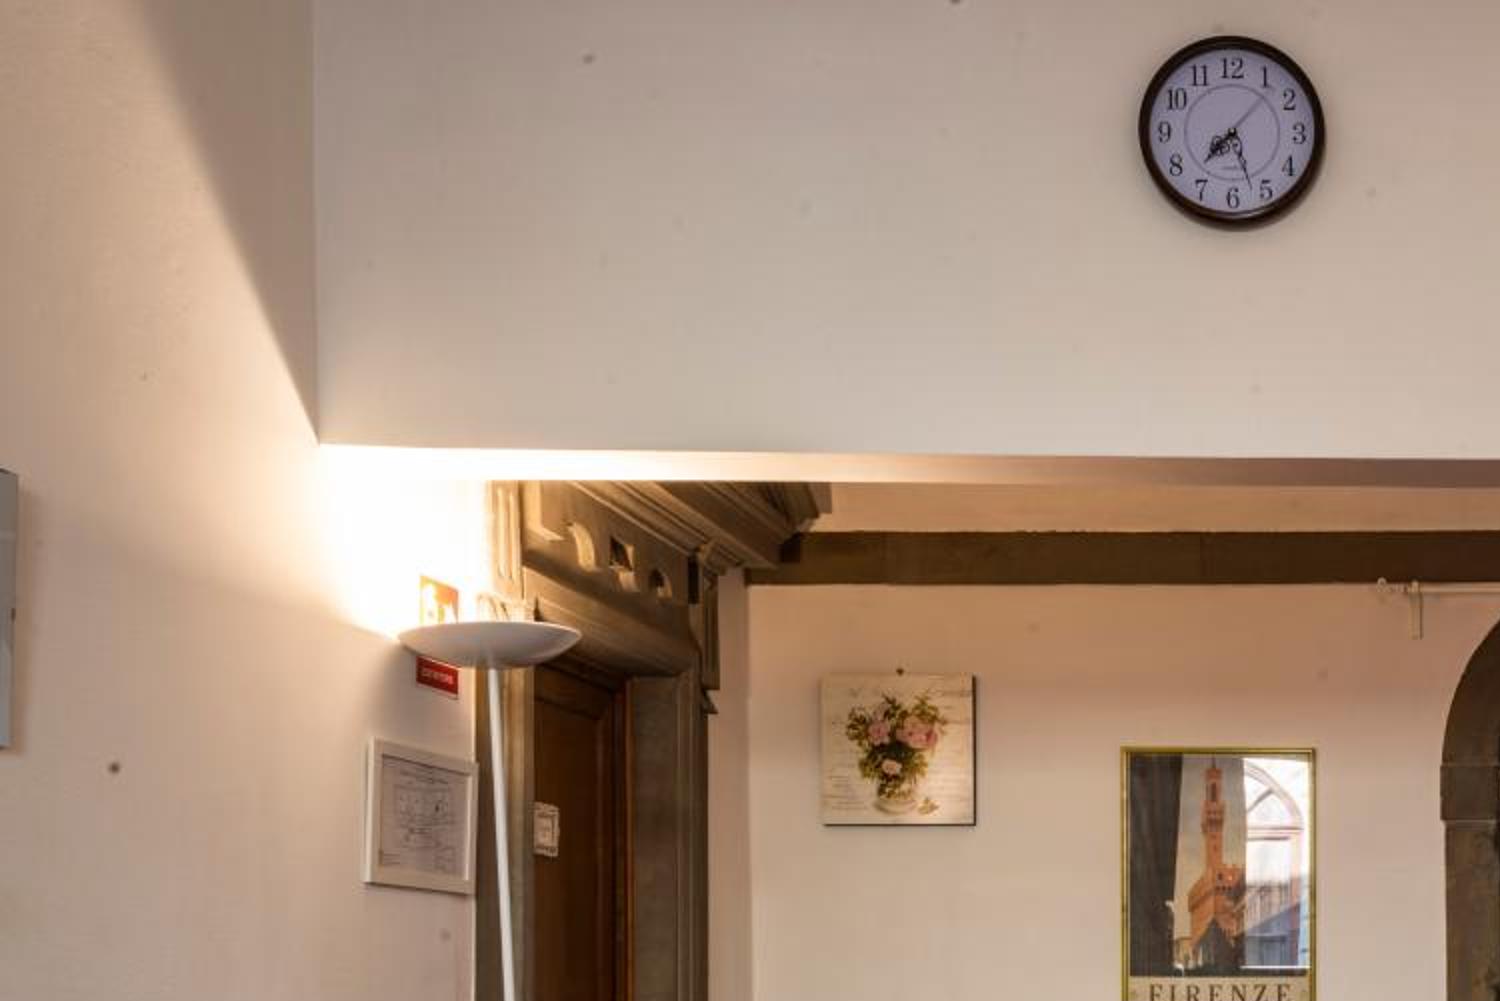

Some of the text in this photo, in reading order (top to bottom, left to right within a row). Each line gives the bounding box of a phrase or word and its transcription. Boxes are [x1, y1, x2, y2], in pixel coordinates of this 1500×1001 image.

[1191, 64, 1208, 86] 11
[1220, 58, 1244, 79] 12
[1261, 66, 1269, 88] 1
[1167, 88, 1187, 110] 10
[1283, 88, 1296, 110] 2
[1158, 121, 1172, 143] 9
[1292, 122, 1306, 144] 3
[1169, 153, 1183, 176] 8
[1282, 155, 1295, 177] 4
[1195, 179, 1208, 201] 7
[1226, 188, 1240, 209] 6
[1259, 180, 1273, 201] 5
